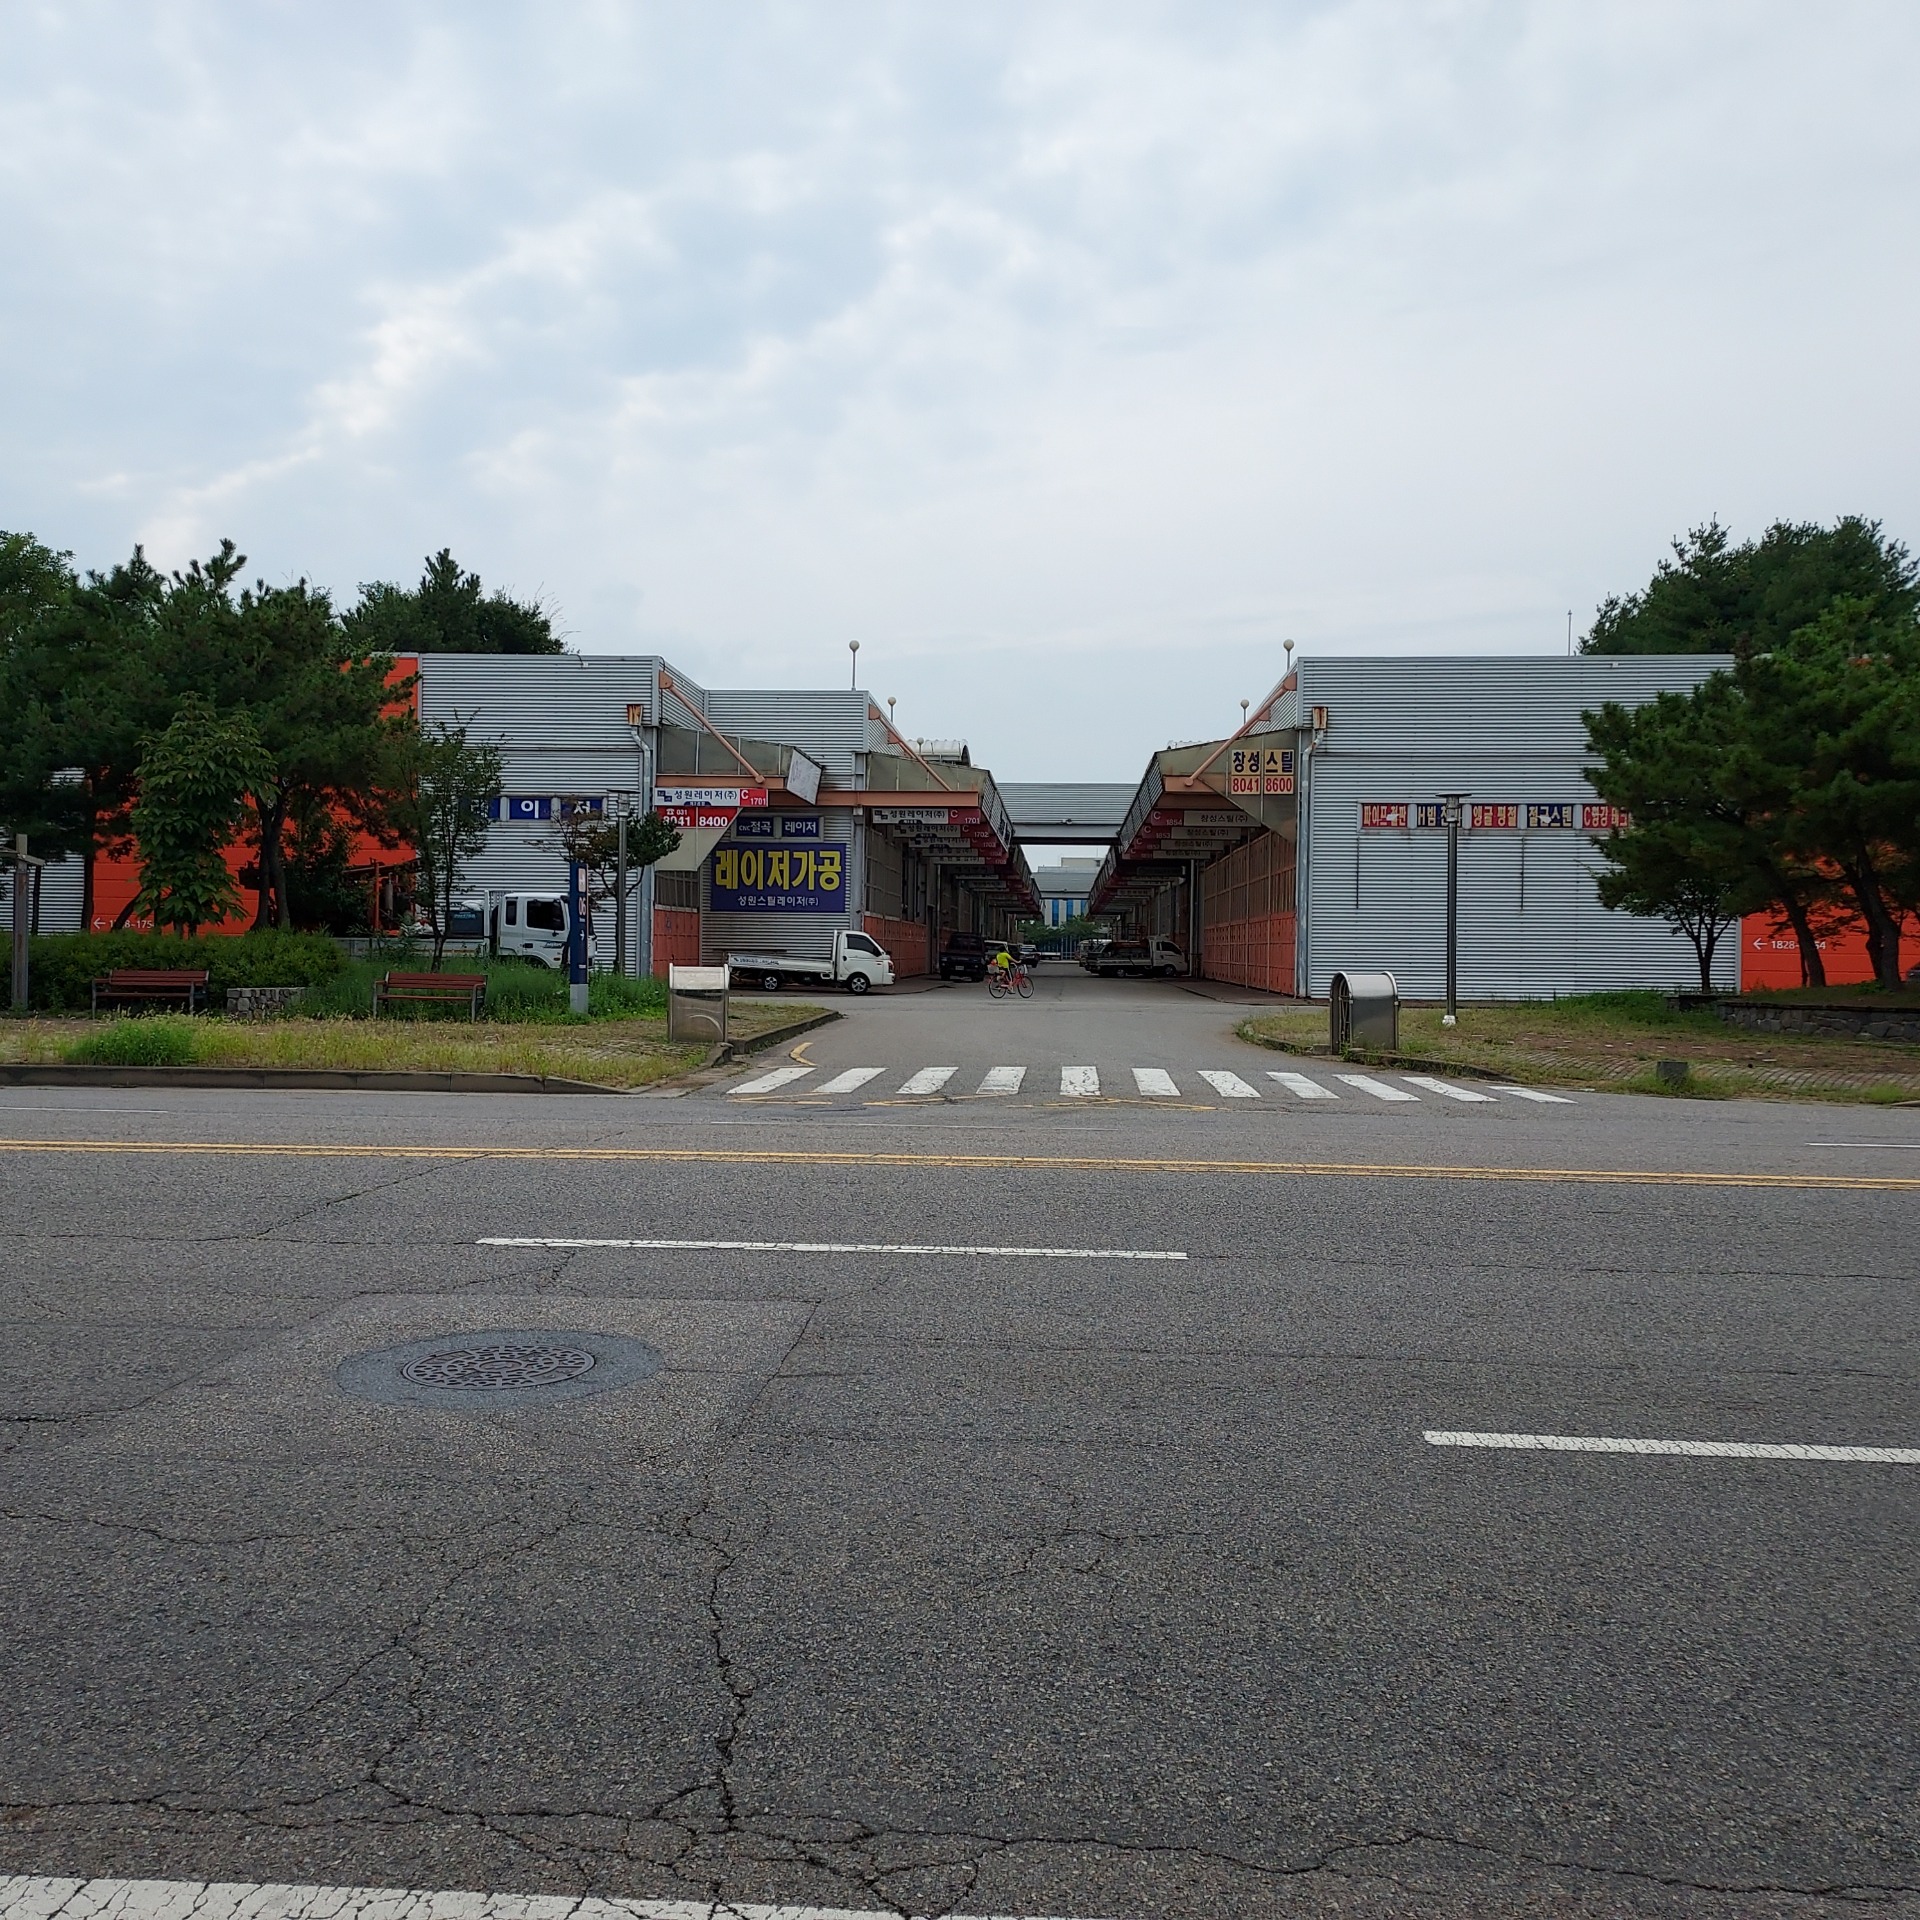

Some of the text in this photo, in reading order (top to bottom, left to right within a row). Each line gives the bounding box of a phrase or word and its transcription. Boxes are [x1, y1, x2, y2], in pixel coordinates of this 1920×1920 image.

[1232, 777, 1293, 793] 8041 8600
[674, 790, 737, 800] 성원레이저(주)
[741, 790, 749, 800] C
[750, 797, 766, 806] 1701
[950, 809, 958, 818] C
[1153, 811, 1161, 820] C
[1364, 805, 1388, 827] 파이프
[1473, 805, 1493, 827] 앵글
[699, 816, 728, 827] 8400
[785, 821, 816, 834] 레이저
[715, 849, 842, 891] 레이저가공
[109, 919, 155, 929] 18-175
[1771, 940, 1826, 950] 1828-54
